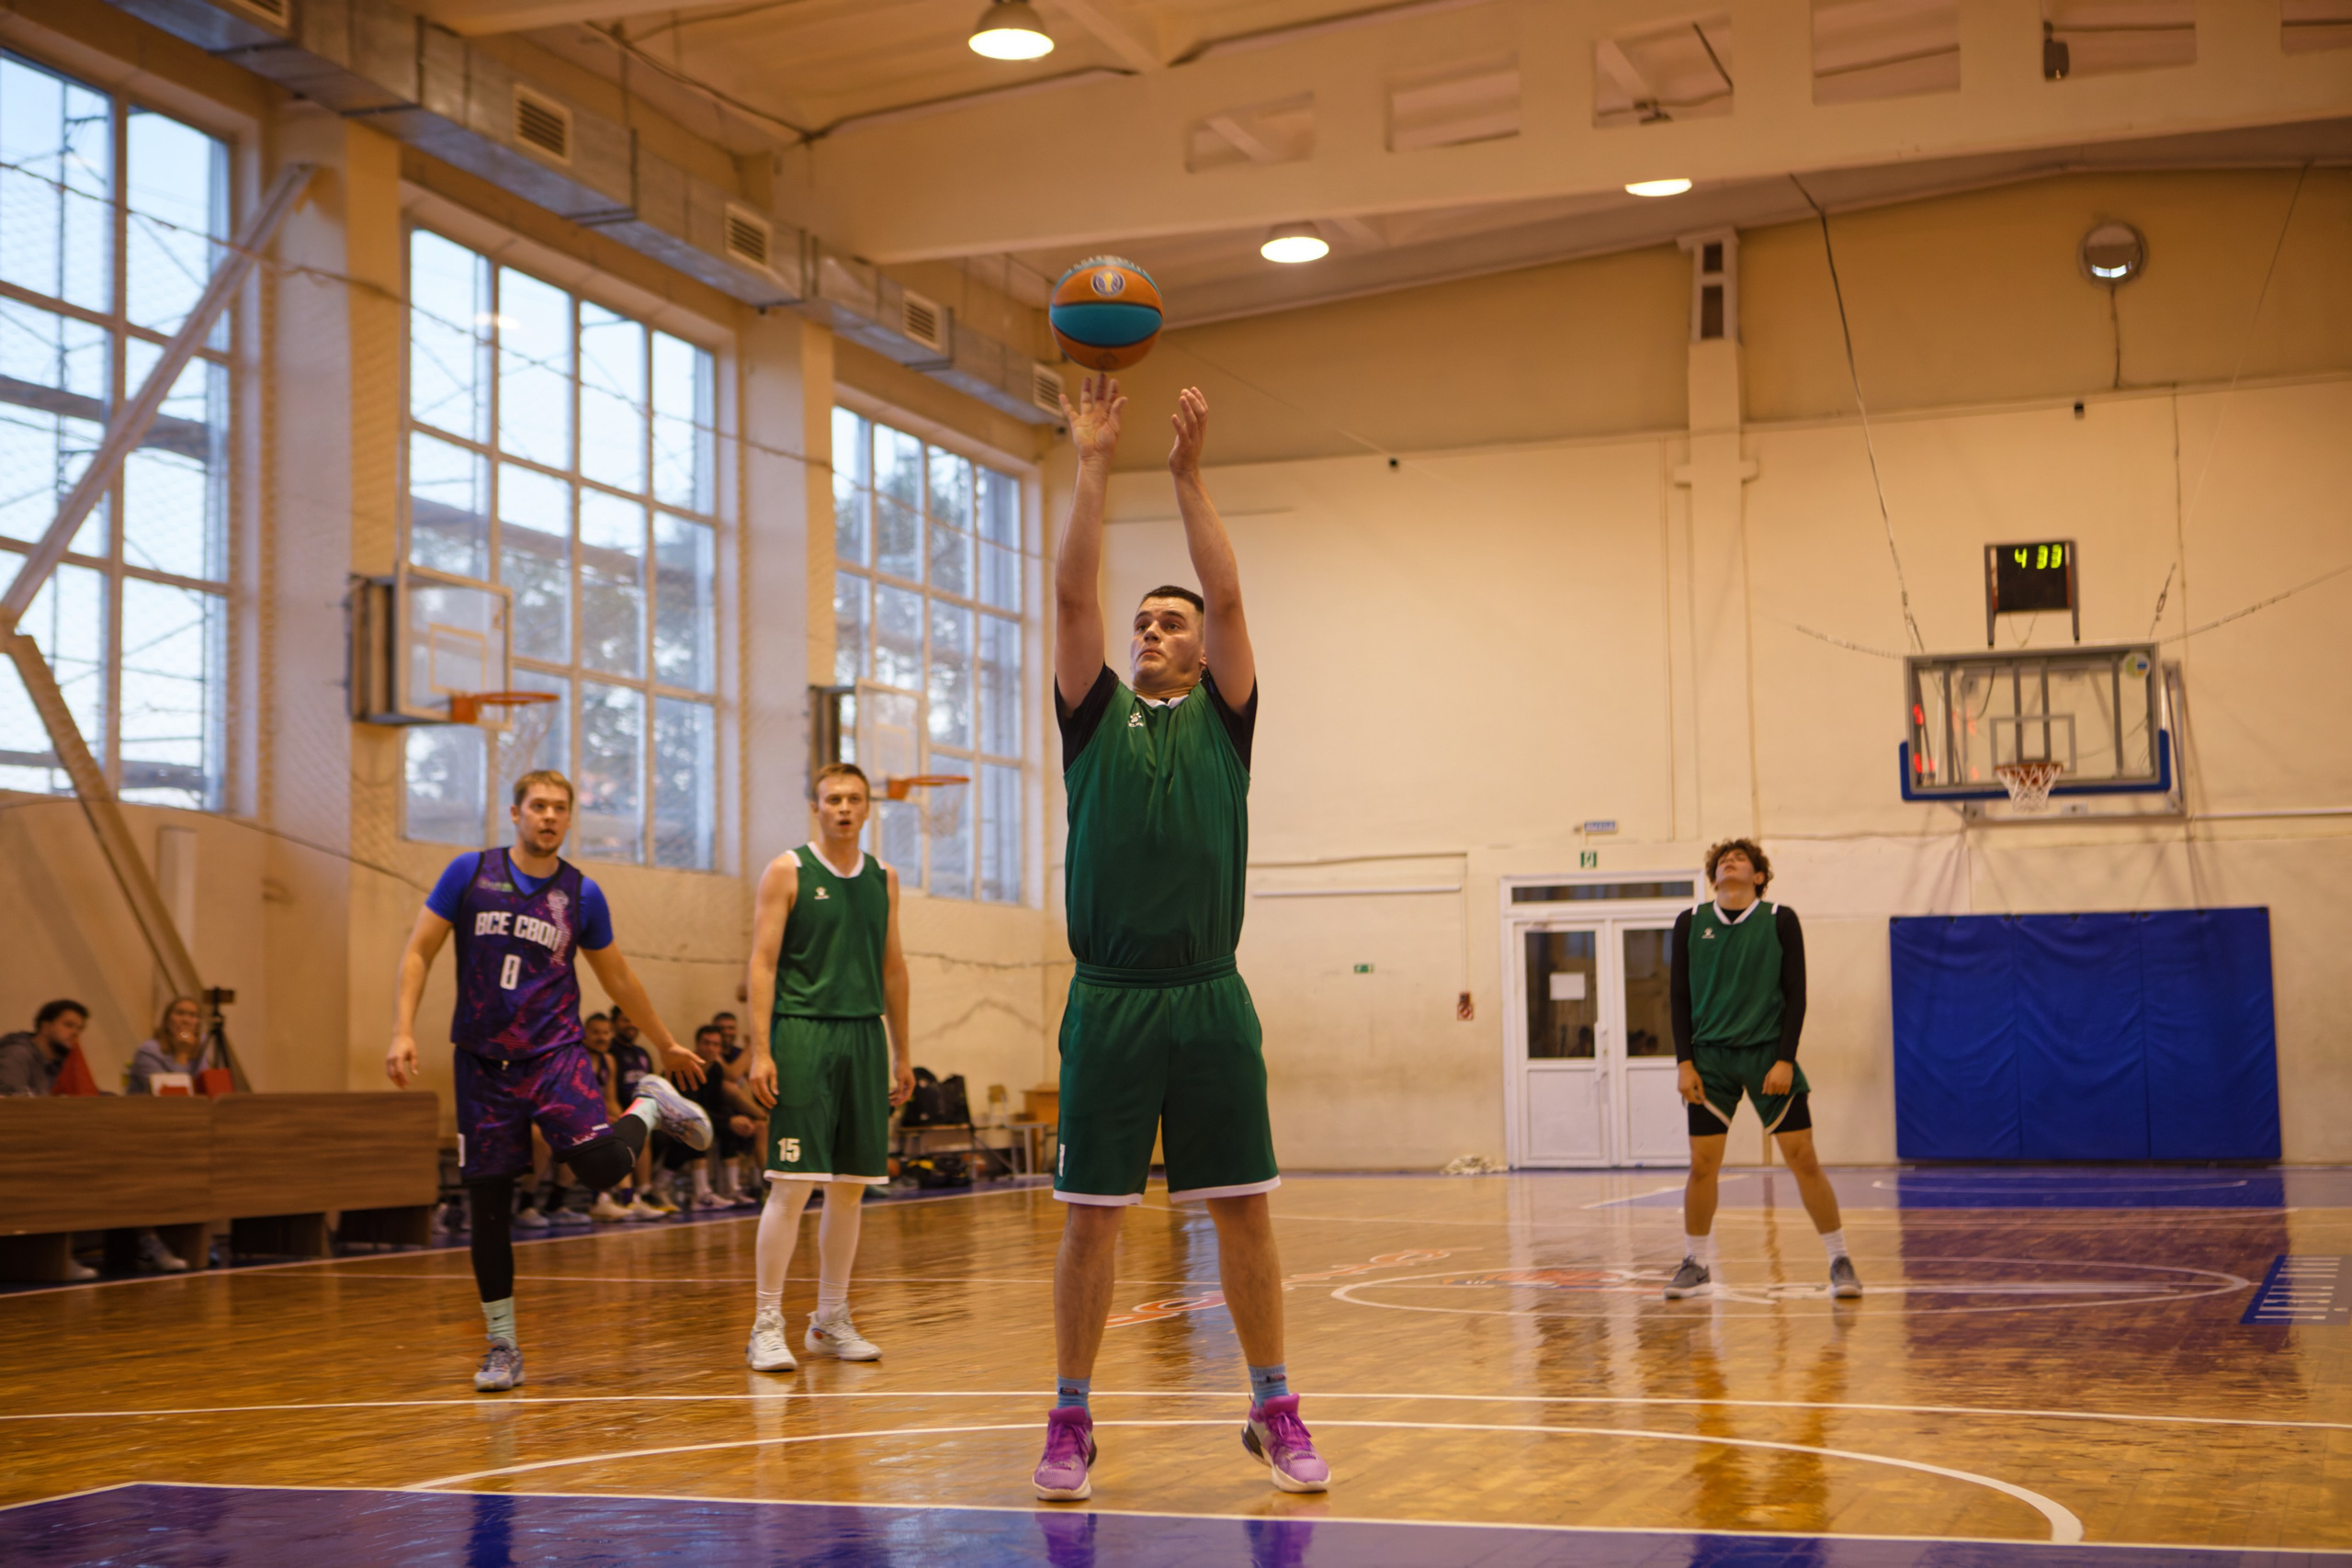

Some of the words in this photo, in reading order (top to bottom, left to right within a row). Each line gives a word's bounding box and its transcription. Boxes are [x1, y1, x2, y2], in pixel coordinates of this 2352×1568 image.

[2014, 547, 2028, 569] 4
[475, 911, 513, 936] ВСЕ
[777, 1137, 801, 1163] 15
